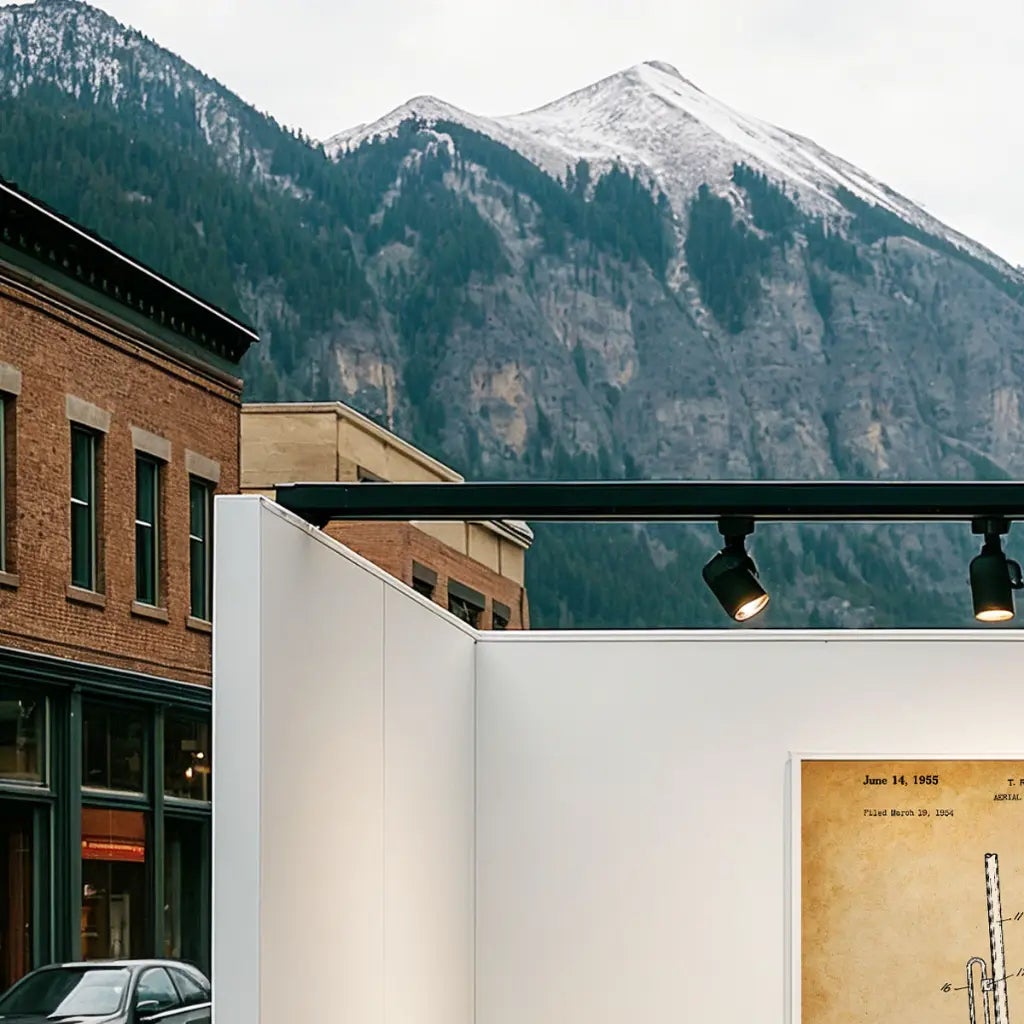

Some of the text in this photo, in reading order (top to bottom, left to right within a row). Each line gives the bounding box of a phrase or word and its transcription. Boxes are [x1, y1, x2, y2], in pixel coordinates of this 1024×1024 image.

[863, 775, 939, 786] June 14, 1955
[863, 809, 954, 818] Filed March 19, 1954
[1013, 911, 1024, 921] 11
[940, 983, 952, 993] 16
